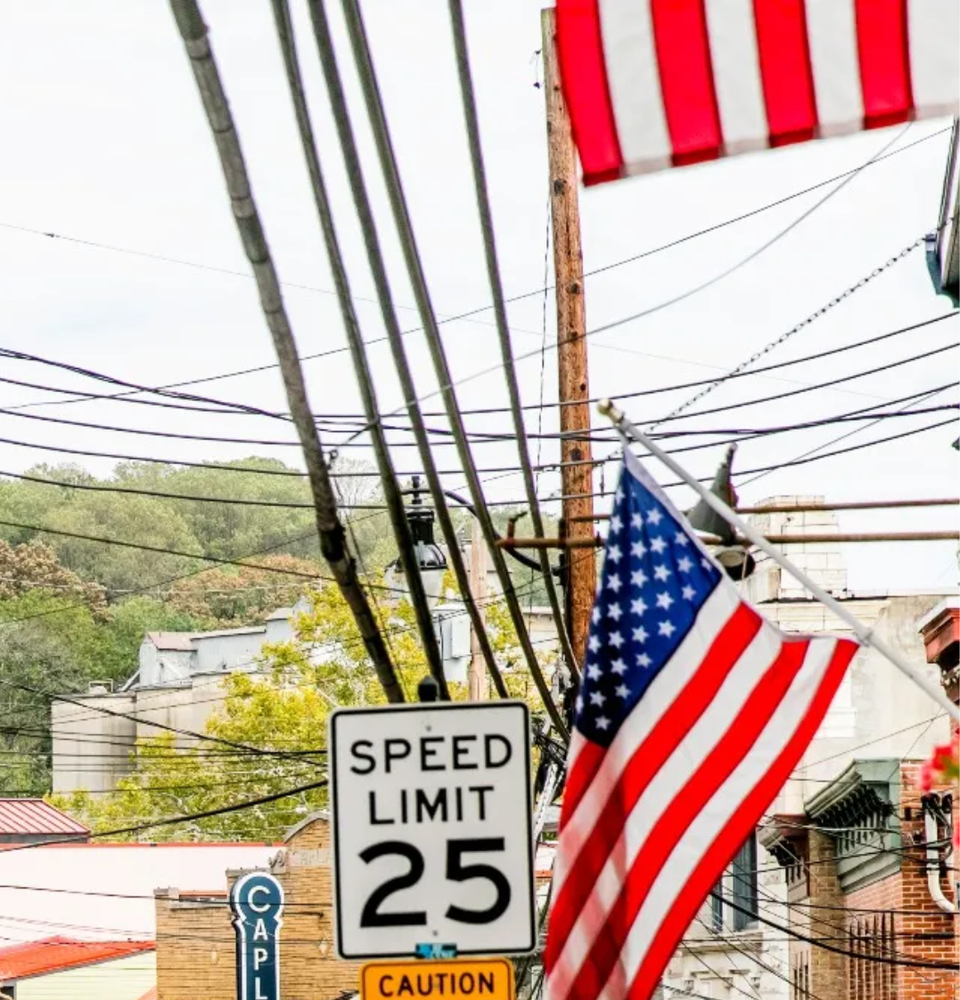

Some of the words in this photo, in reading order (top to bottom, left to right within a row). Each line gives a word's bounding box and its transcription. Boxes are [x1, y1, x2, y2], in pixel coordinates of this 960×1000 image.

[350, 734, 512, 775] SPEED
[368, 785, 495, 825] LIMIT
[358, 836, 512, 928] 25
[378, 972, 495, 997] CAUTION
